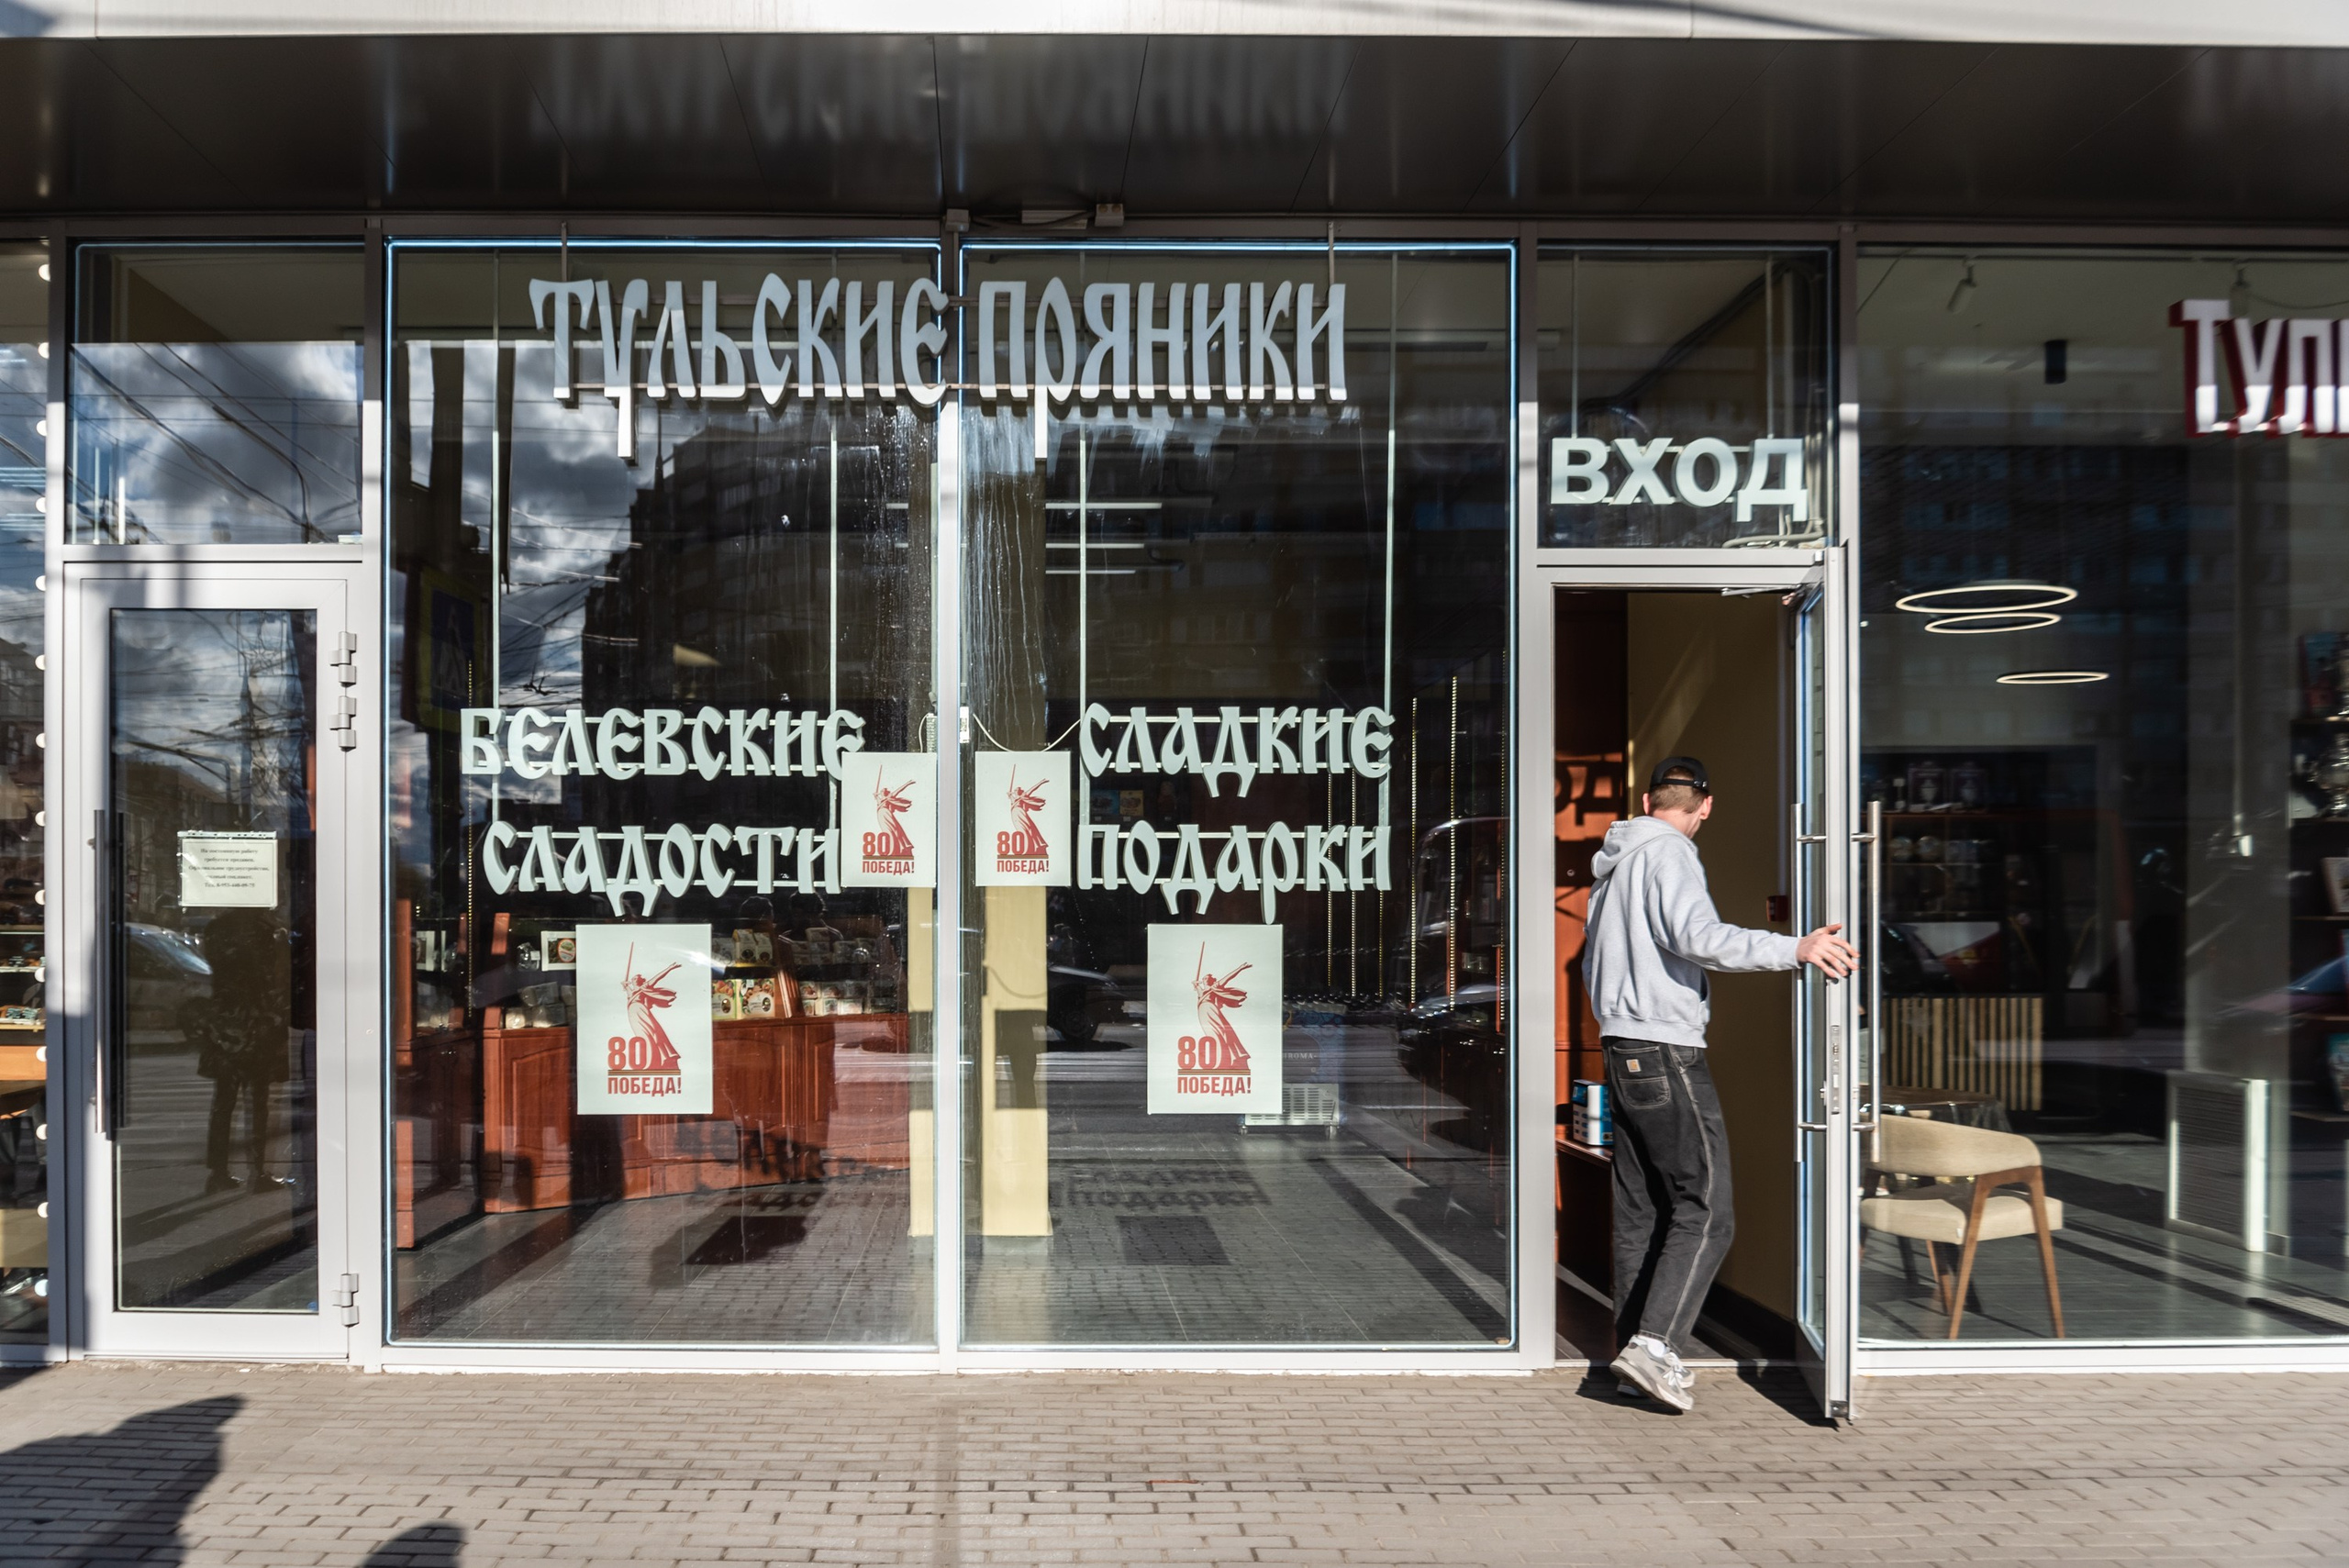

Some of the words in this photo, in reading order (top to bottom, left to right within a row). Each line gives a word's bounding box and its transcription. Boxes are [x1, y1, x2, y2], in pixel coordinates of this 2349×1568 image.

[529, 272, 949, 458] ТУЛЬСКИЕ
[978, 276, 1348, 459] ПРЯНИКИ
[1550, 437, 1809, 522] ВХОД
[461, 706, 865, 781] БЕЛЕВСКИЕ
[1079, 703, 1396, 798] СЛАДКИЕ
[863, 832, 890, 856] 80
[996, 831, 1025, 855] 80
[483, 820, 841, 917] СЛАДОСТИ
[863, 861, 915, 875] ПОБЕДА!
[996, 860, 1049, 874] ПОБЕДА!
[1077, 820, 1392, 925] ПОДАРКИ
[607, 1036, 647, 1071] 80
[1177, 1035, 1217, 1070] 80
[607, 1076, 682, 1097] ПОБЕДА!
[1177, 1076, 1252, 1096] ПОБЕДА!
